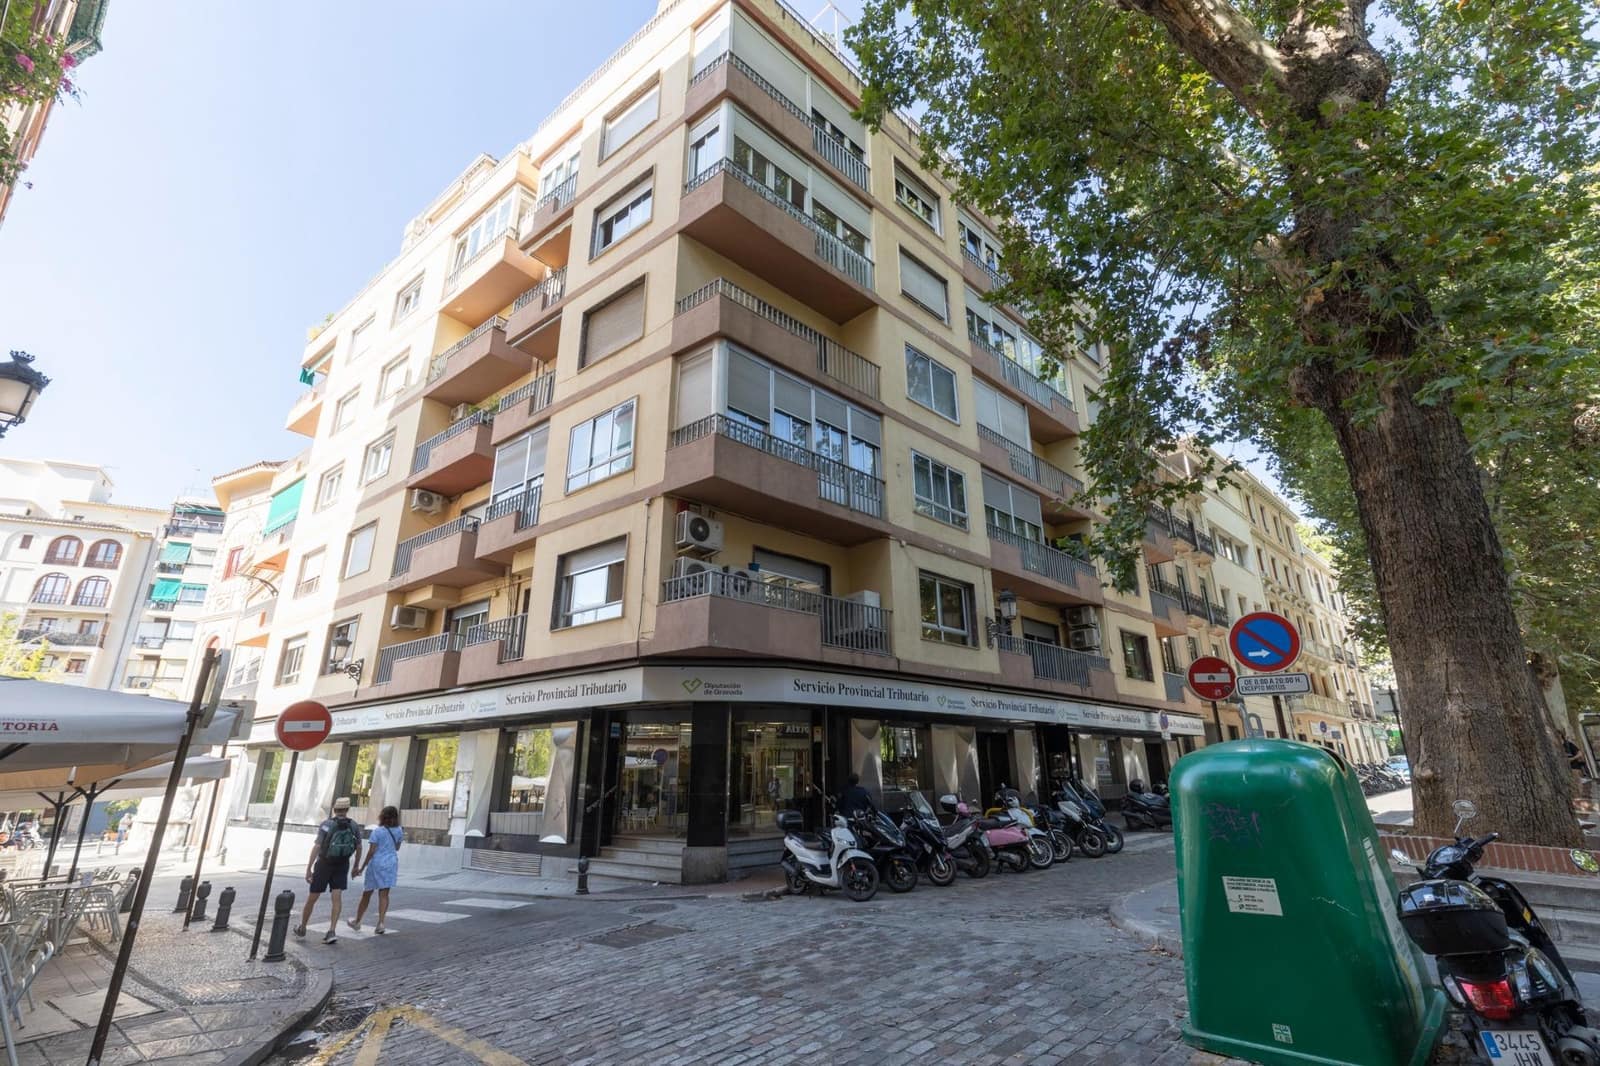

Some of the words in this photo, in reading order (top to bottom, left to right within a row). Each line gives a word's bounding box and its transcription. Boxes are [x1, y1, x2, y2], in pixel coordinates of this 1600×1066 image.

[505, 693, 536, 706] Servicio
[537, 685, 578, 702] Provincial
[580, 679, 628, 697] Tributario
[793, 679, 836, 695] Servicio
[838, 683, 885, 699] Provincial
[886, 687, 929, 703] Tributario
[384, 710, 405, 720] Servicio
[405, 704, 434, 719] Provincial
[434, 701, 465, 715] Tributario
[970, 696, 998, 710] Servicio
[998, 699, 1028, 713] Provincial
[1028, 703, 1055, 715] Tributario
[0, 721, 59, 731] TORIA
[1495, 1033, 1541, 1051] 3445
